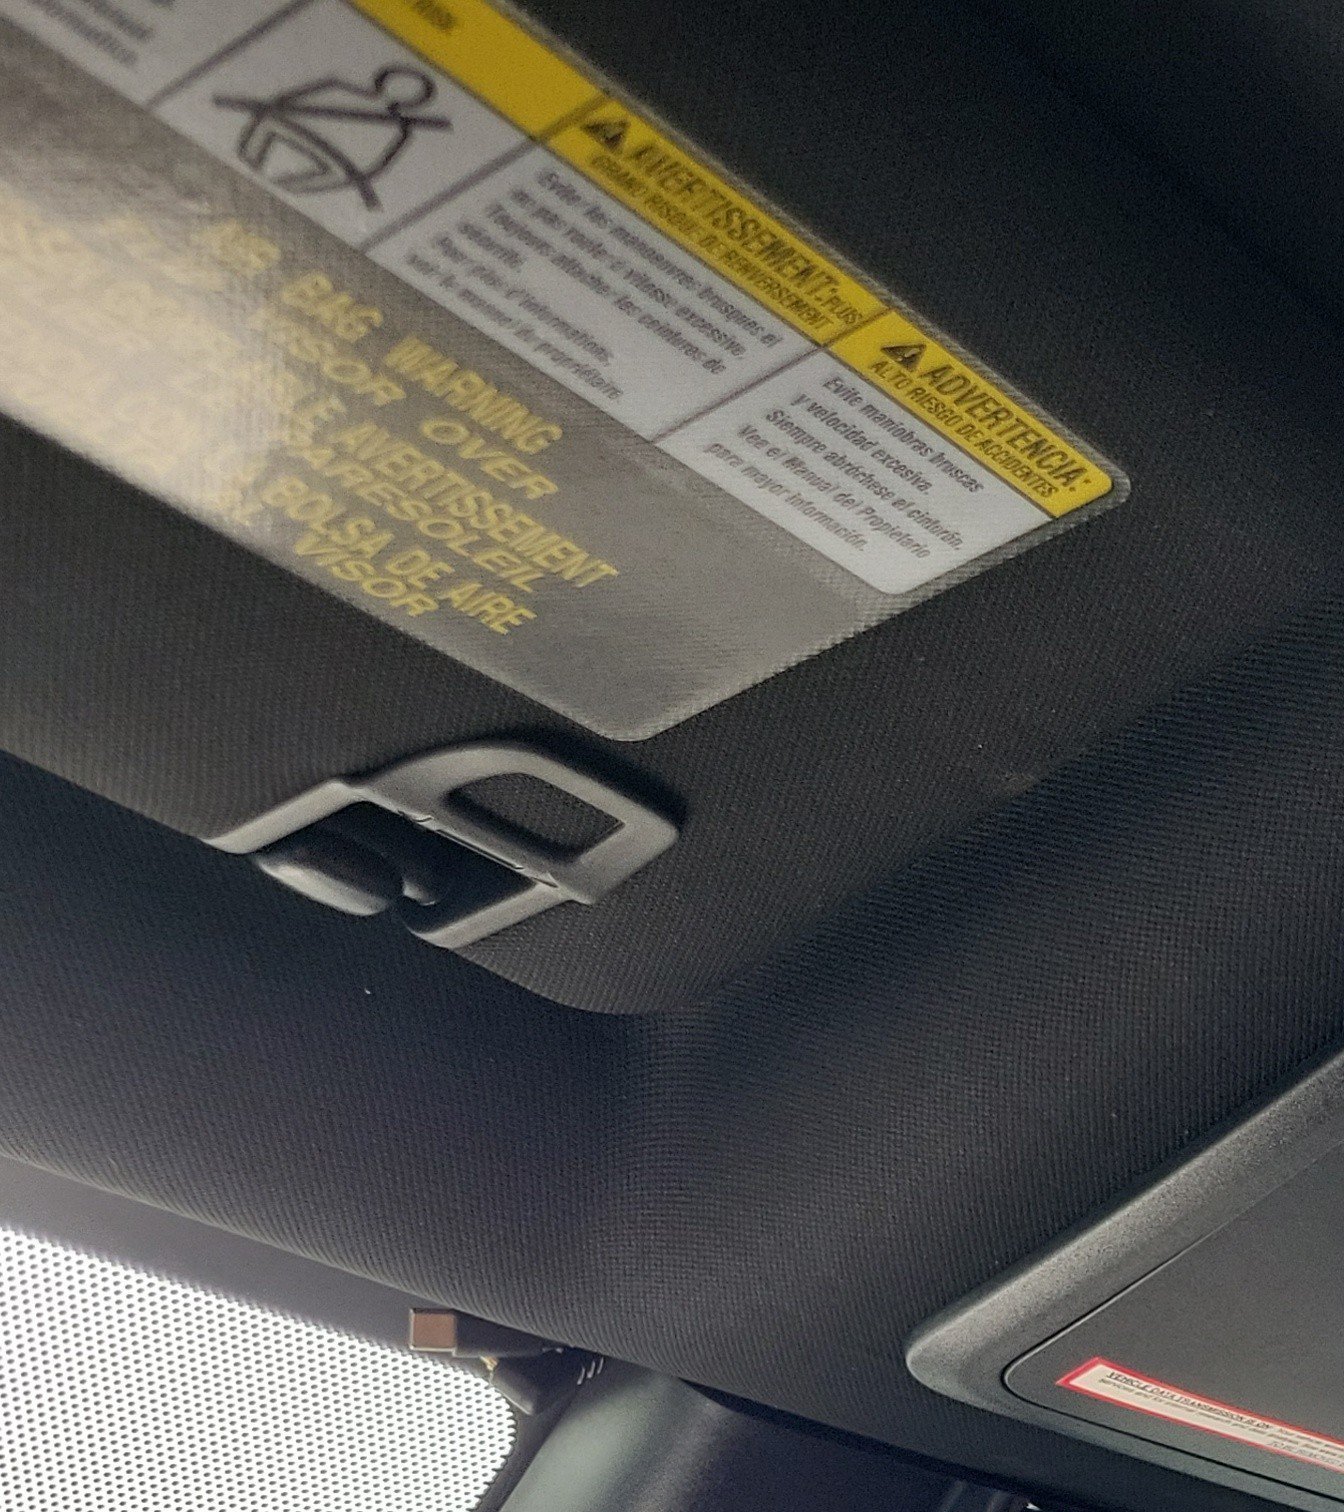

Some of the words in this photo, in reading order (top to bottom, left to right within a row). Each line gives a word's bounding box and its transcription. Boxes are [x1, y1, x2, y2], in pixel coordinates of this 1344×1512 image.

[382, 334, 564, 456] WARNING
[759, 408, 831, 456] Siempre
[788, 393, 813, 408] y
[802, 400, 880, 452] velocidad
[869, 447, 942, 495] excesiva.
[821, 376, 868, 407] Evite
[857, 401, 938, 457] maniobras
[927, 452, 989, 494] bruscas
[866, 358, 914, 390] ALTO
[904, 386, 965, 428] RIESGO
[953, 422, 986, 443] DE
[971, 436, 1060, 498] ACCIDENTES
[916, 361, 1101, 493] ADVERTENCIA:
[333, 419, 620, 590] AVERTISSEMENT
[419, 416, 560, 501] OVER
[701, 441, 748, 470] para
[736, 463, 793, 499] mayor
[783, 492, 875, 552] información.
[733, 424, 774, 450] Vea
[762, 444, 790, 461] el
[779, 455, 840, 495] Manual
[829, 489, 864, 511] del
[850, 505, 935, 560] Propietario
[263, 472, 396, 571] BOLSA
[388, 547, 456, 590] DE
[445, 580, 540, 638] AIRE
[292, 532, 441, 619] VISOR
